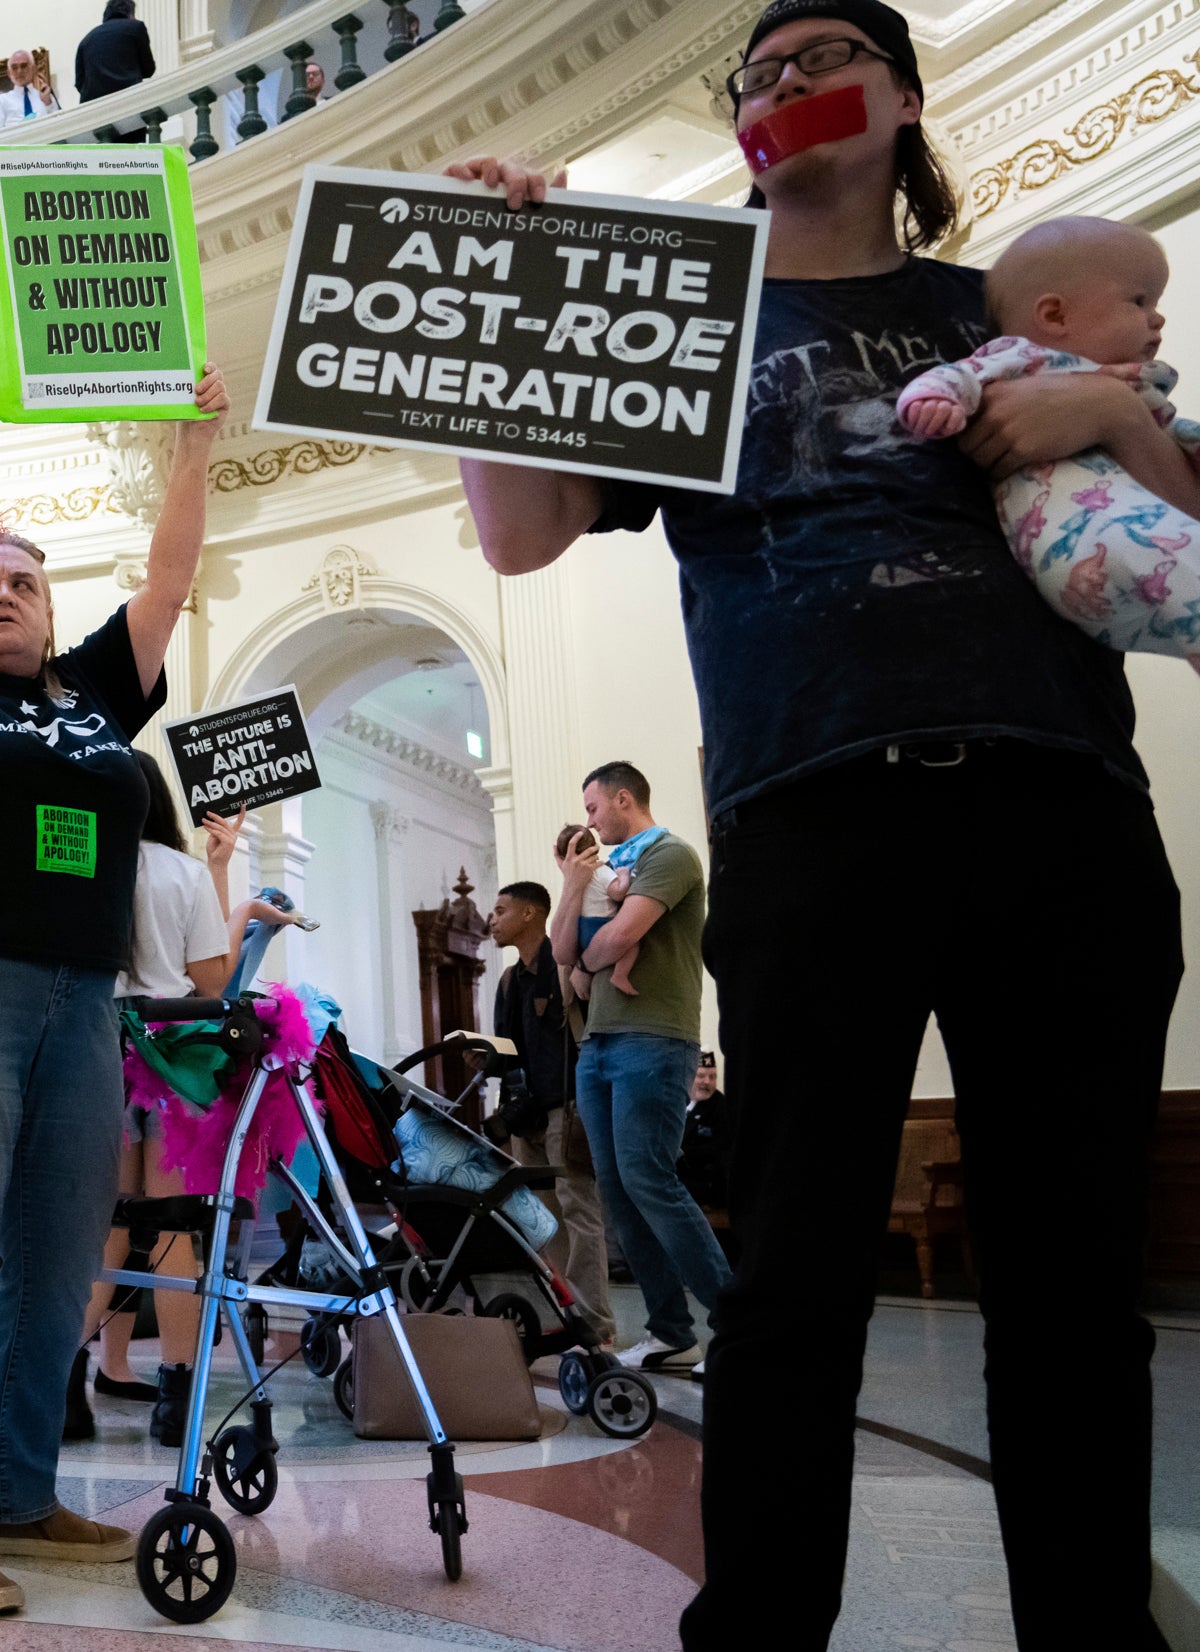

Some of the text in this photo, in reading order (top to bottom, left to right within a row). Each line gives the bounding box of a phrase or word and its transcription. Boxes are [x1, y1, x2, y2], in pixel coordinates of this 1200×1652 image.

[0, 160, 159, 172] #RiseUp4AbortionRights #Green4Abortion
[24, 190, 151, 222] ABORTION
[413, 204, 683, 249] STUDENTSFORLIFE.ORG
[14, 233, 171, 267] ON DEMAND
[332, 224, 711, 304] I AM THE
[28, 276, 168, 311] & WITHOUT
[46, 321, 162, 355] APOLOGY
[299, 274, 736, 372] POST-ROE
[45, 380, 194, 398] RiseUp4AbortionRights.org
[296, 343, 710, 437] GENERATION
[400, 409, 588, 449] TEXT LIFE TO 53445
[199, 702, 278, 733] STUDENTSFORLIFE.ORG
[69, 741, 119, 760] TAKE
[182, 714, 292, 758] THE FUTURE IS
[213, 739, 276, 775] ANTI-
[191, 750, 312, 807] ABORTION
[43, 809, 89, 826] ABORTION
[229, 802, 243, 810] TEXT
[257, 793, 265, 801] TO
[42, 834, 89, 849] & WITHOUT
[44, 824, 89, 837] ON DEMAND
[44, 846, 89, 865] APOLOGY!
